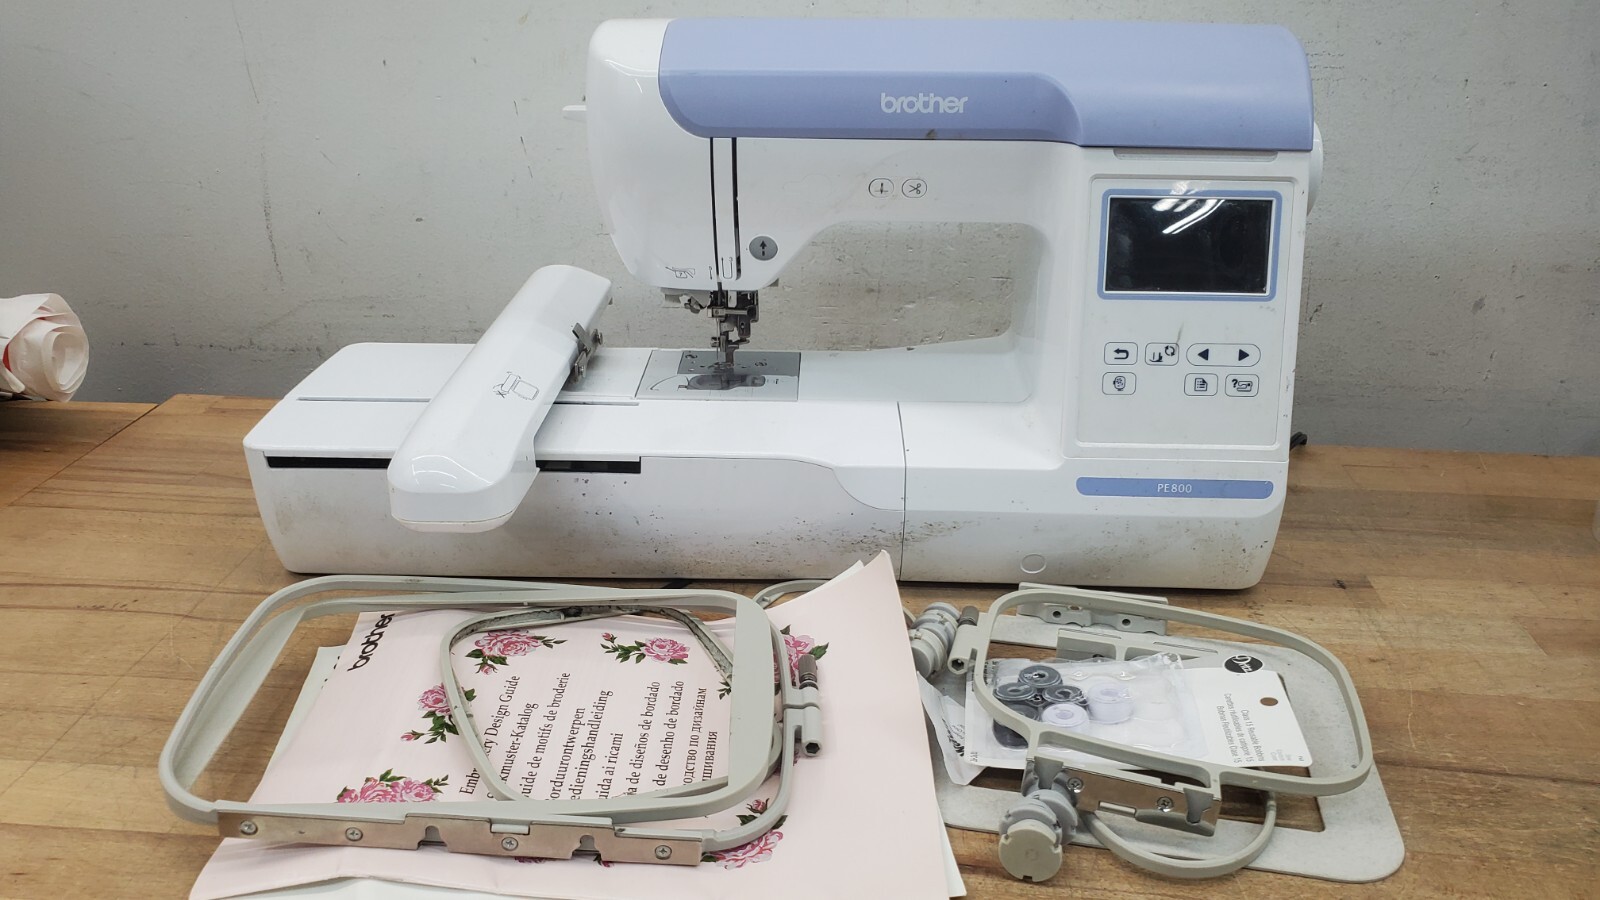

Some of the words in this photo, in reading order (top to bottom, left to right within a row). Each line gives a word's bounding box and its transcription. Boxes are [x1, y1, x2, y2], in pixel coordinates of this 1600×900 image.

[879, 92, 969, 114] brother
[1157, 483, 1193, 494] PE800
[347, 613, 395, 672] brother
[484, 704, 511, 737] Design
[499, 675, 520, 703] Guide
[547, 673, 571, 709] broderie
[640, 681, 661, 717] bordado
[666, 680, 685, 717] bordado
[543, 710, 558, 721] de
[638, 719, 653, 731] de
[664, 717, 678, 730] de
[692, 687, 707, 733] дизайнам
[536, 723, 553, 754] motifs
[548, 708, 586, 800] orduurontwerpen
[569, 690, 614, 800] edieningshandleiding
[605, 733, 624, 764] ricami
[629, 732, 650, 769] diseños
[655, 731, 675, 771] desenho
[692, 734, 700, 748] по
[527, 756, 542, 769] de
[602, 766, 616, 776] ai
[702, 731, 718, 781] шивания
[519, 772, 538, 798] uide
[595, 778, 613, 800] uida
[626, 772, 640, 784] de
[652, 773, 667, 787] de
